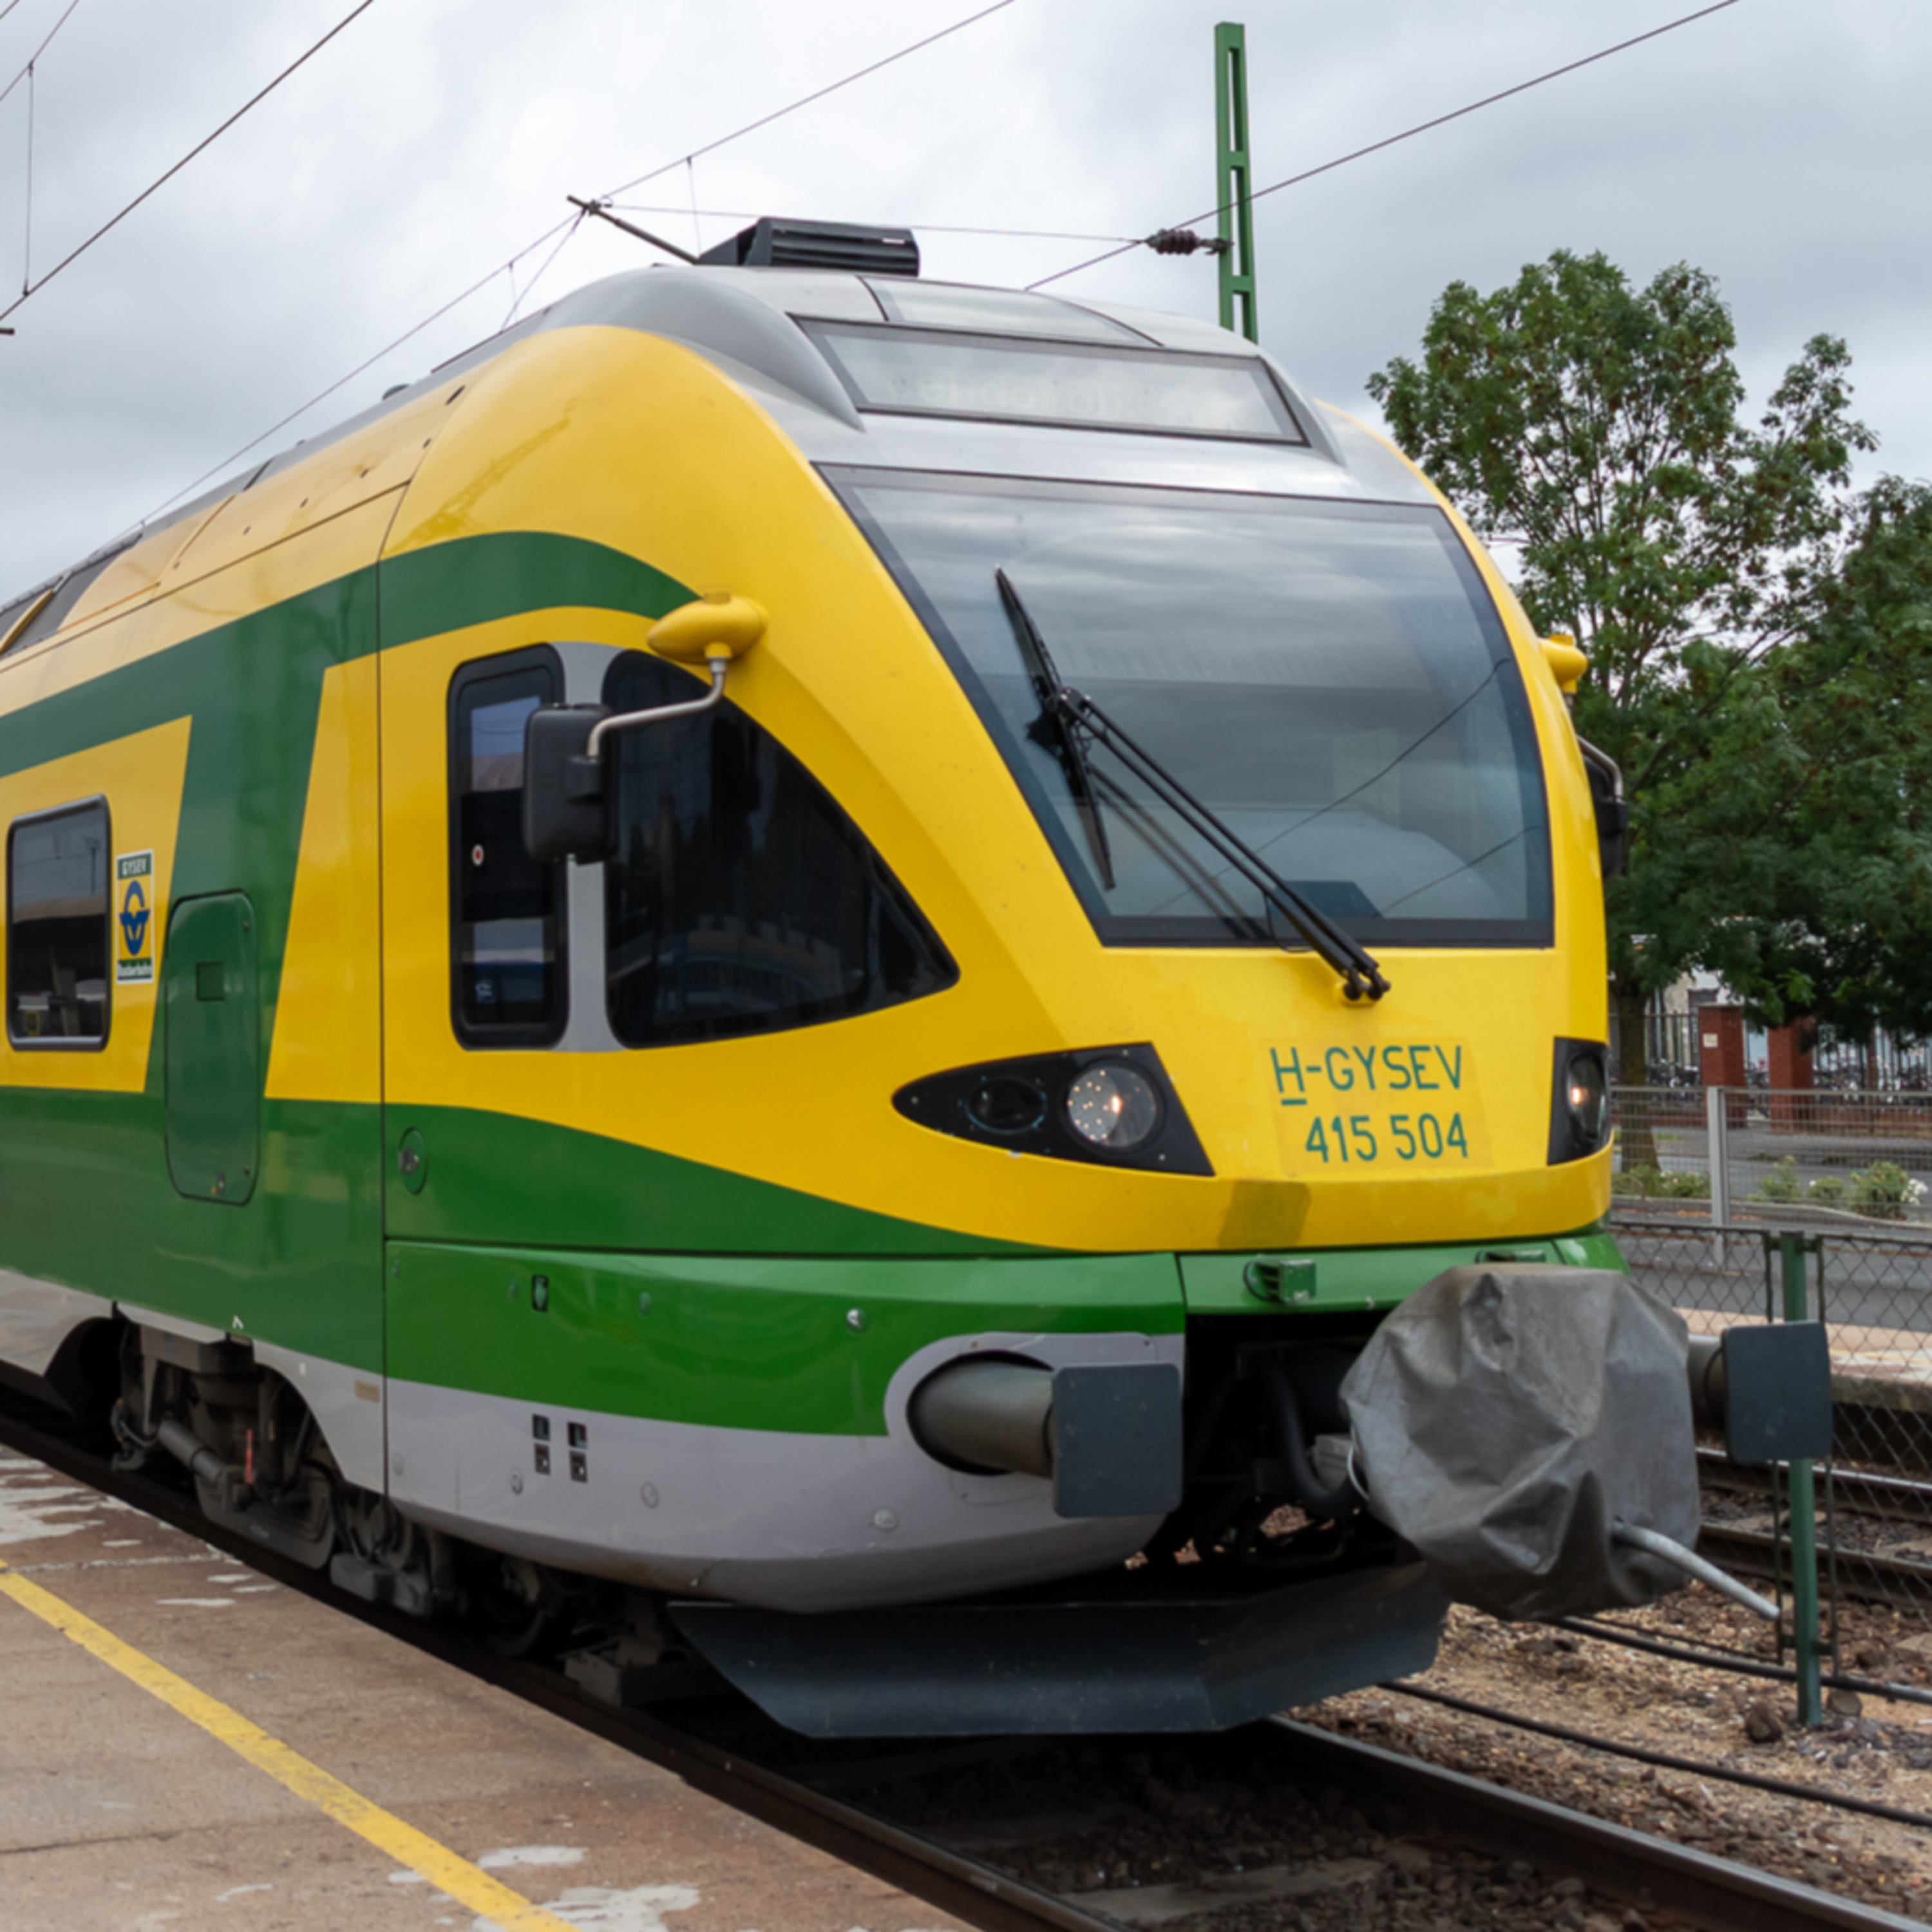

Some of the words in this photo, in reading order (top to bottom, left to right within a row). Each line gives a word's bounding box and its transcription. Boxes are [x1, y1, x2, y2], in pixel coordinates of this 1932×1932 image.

[122, 859, 146, 876] GYSEV
[1270, 1045, 1462, 1094] H-GYSEV
[1305, 1115, 1378, 1163] 415
[1390, 1112, 1468, 1160] 504
